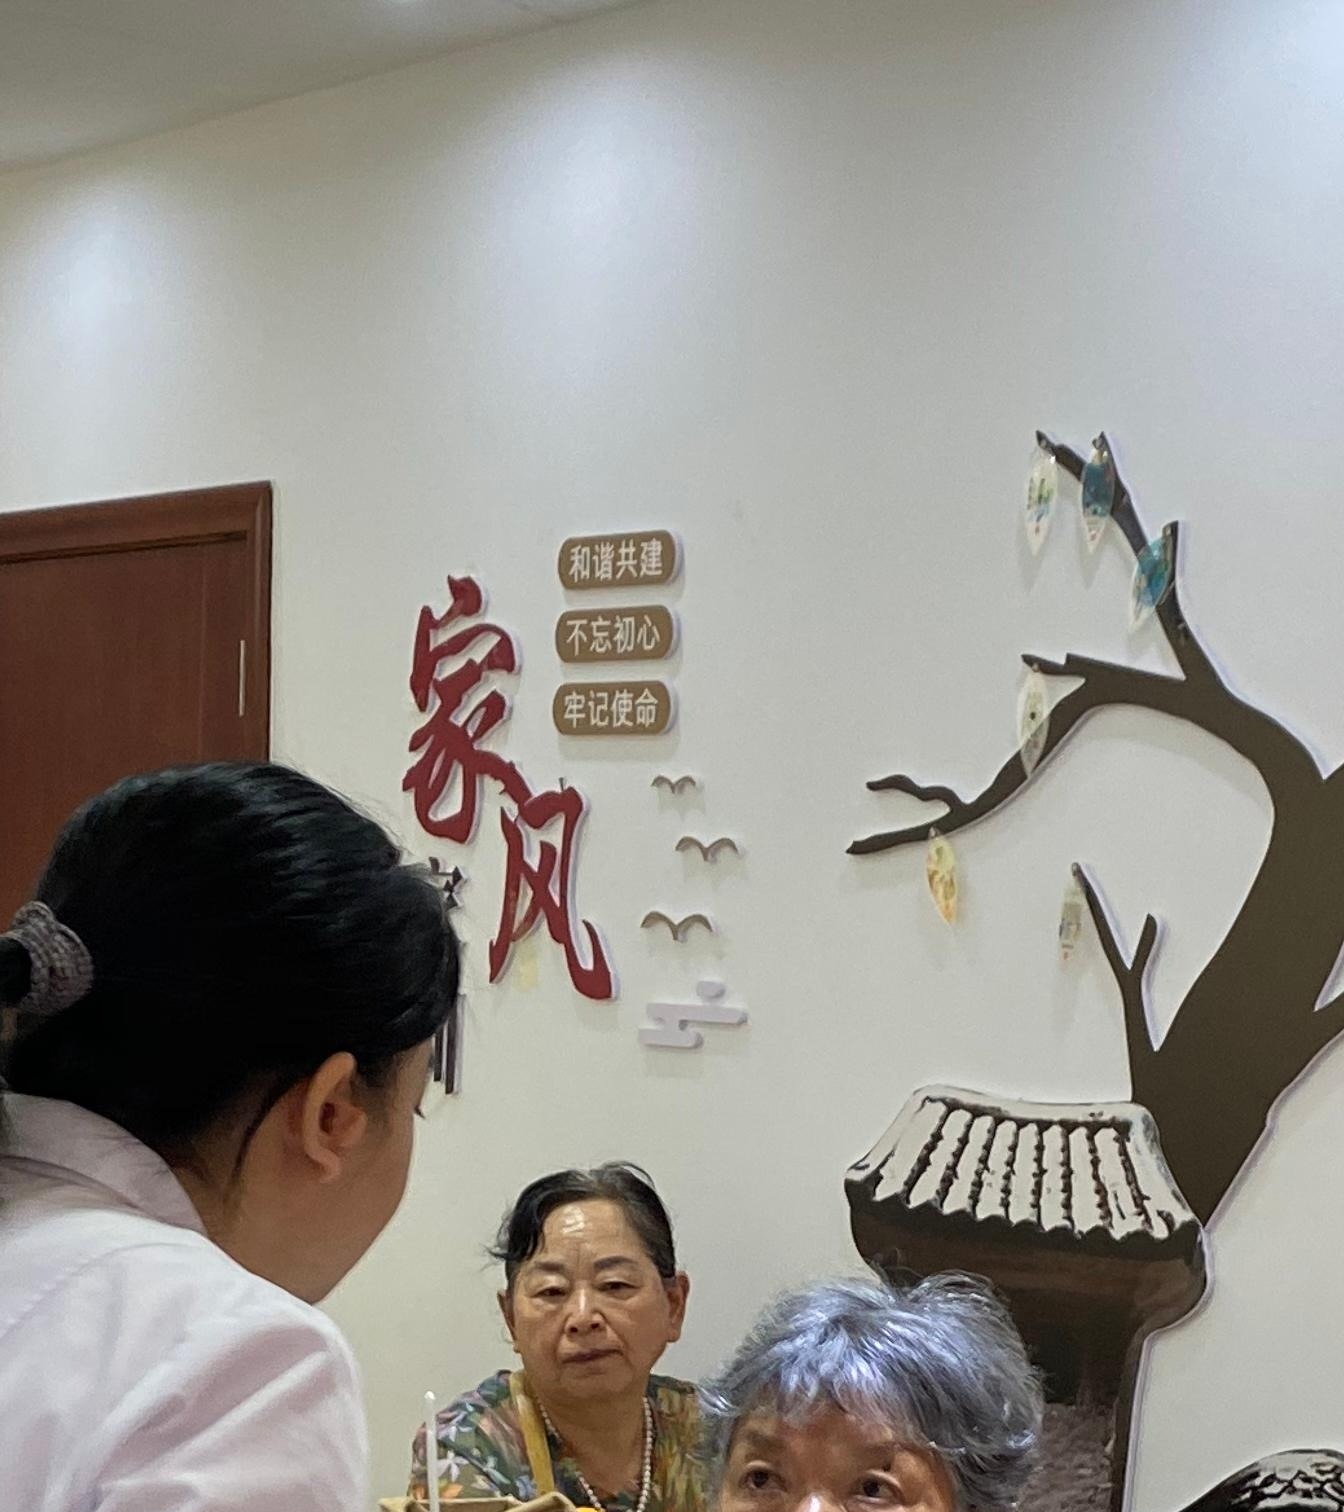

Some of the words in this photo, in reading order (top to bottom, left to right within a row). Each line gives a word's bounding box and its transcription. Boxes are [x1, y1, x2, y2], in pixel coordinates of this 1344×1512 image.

[568, 537, 663, 583] 和谐共建
[566, 614, 660, 656] 不忘初心
[564, 688, 658, 728] 牢记使命
[402, 574, 612, 1000] 家风
